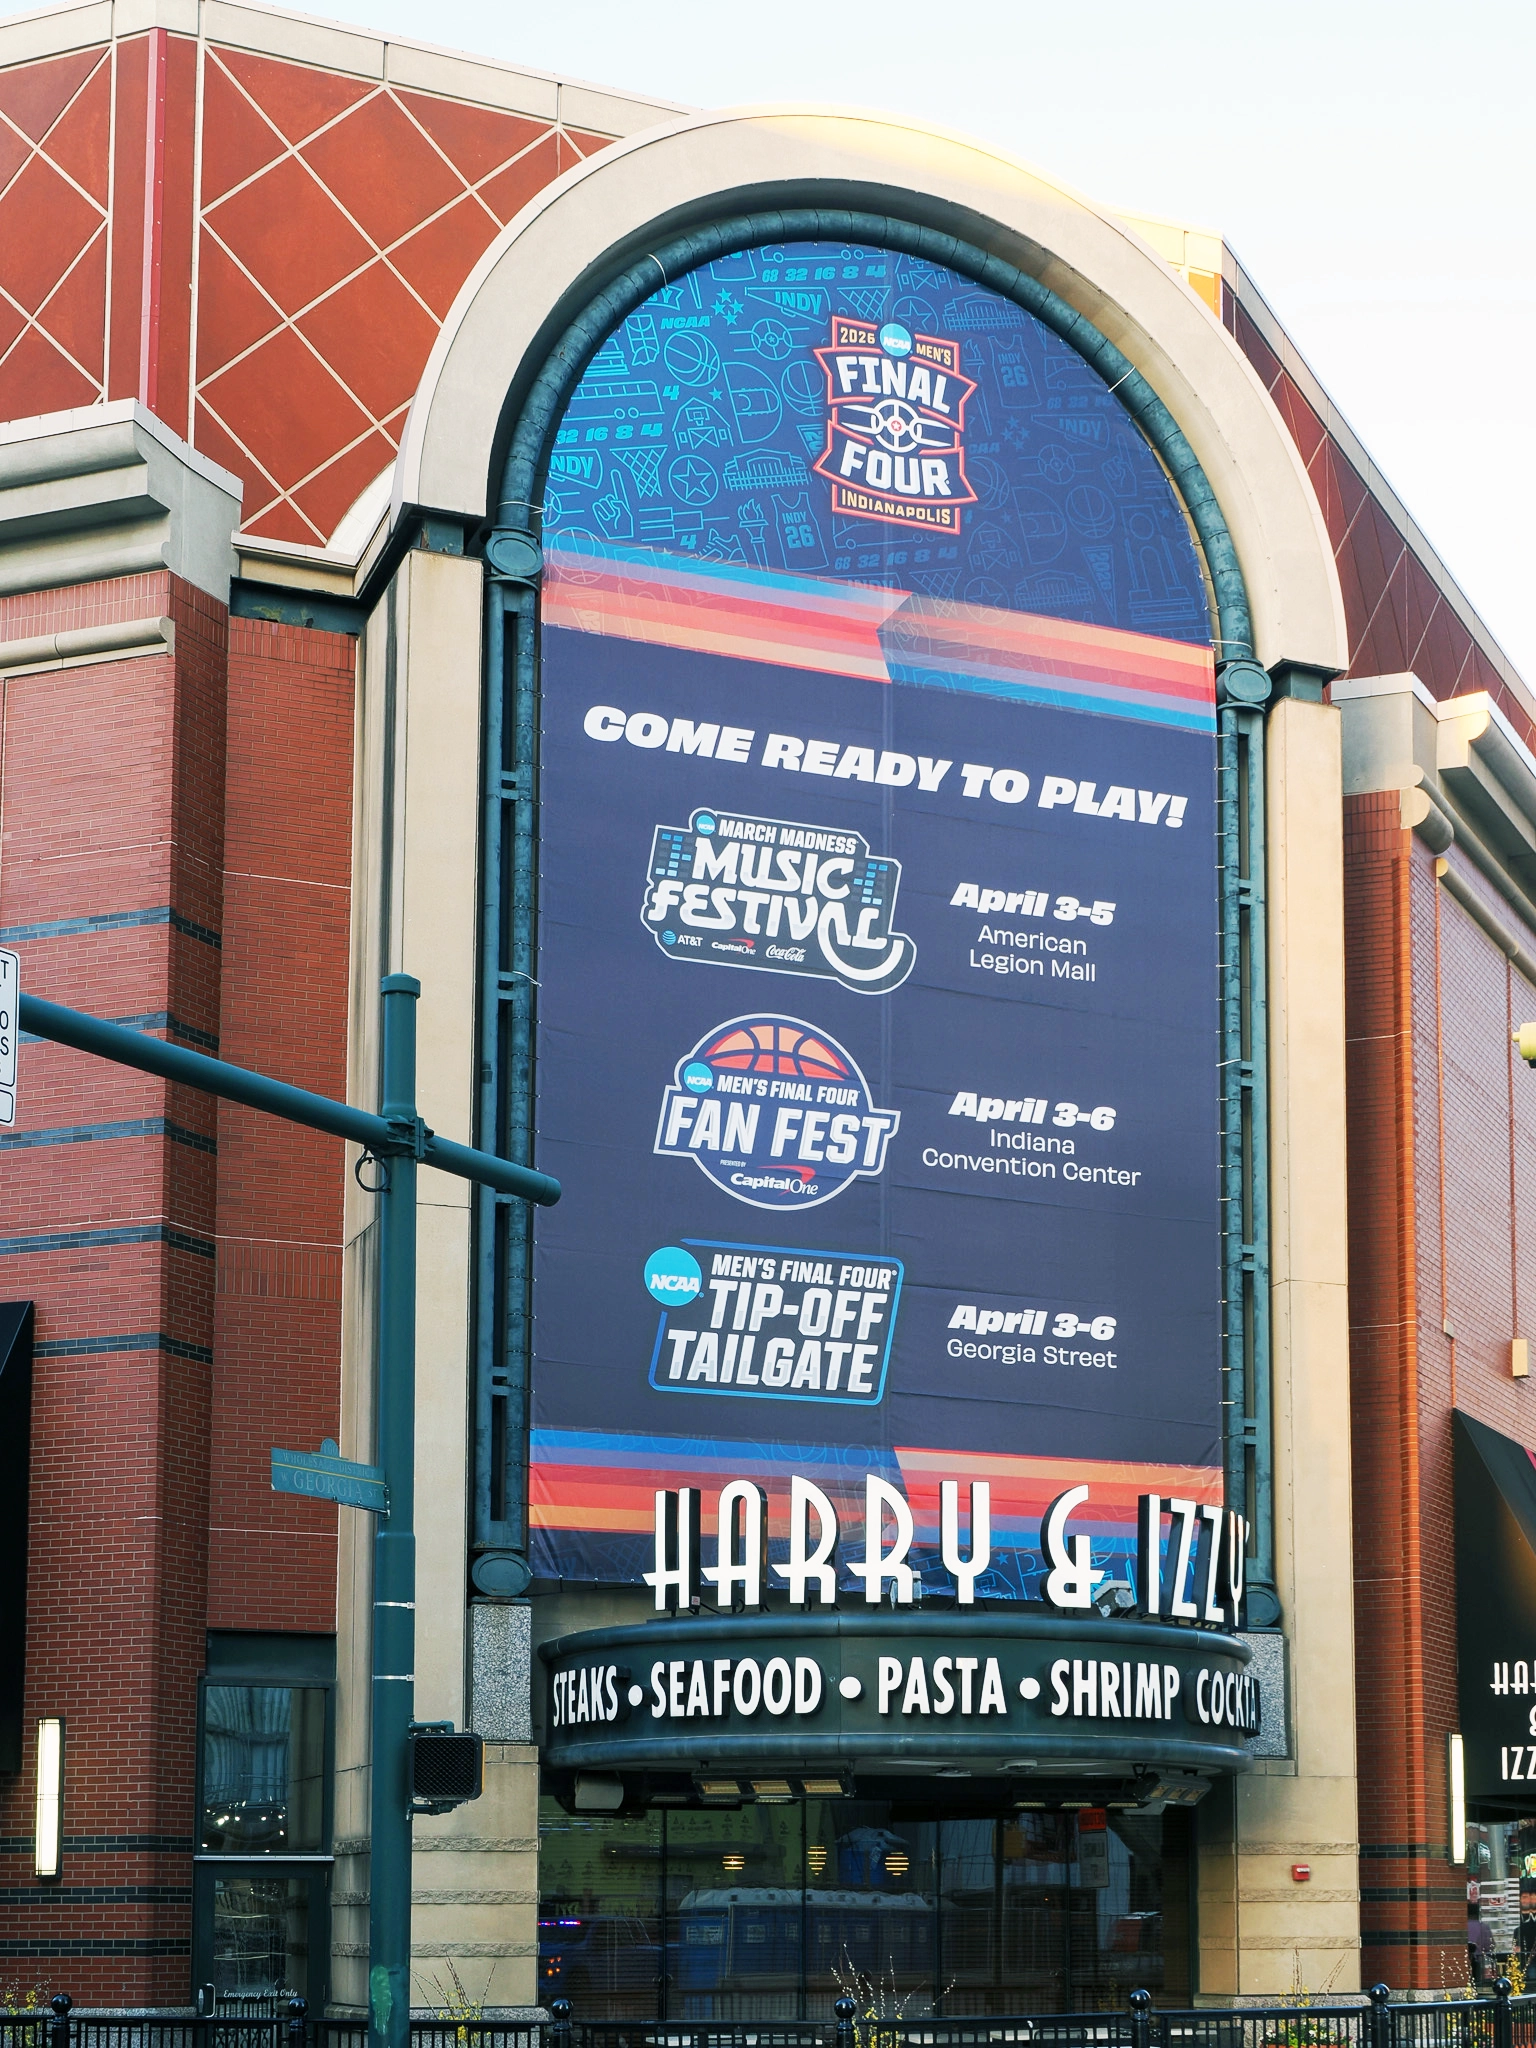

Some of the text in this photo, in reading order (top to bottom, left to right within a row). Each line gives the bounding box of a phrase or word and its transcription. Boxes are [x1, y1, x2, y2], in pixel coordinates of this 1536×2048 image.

[762, 265, 886, 283] 68 32 16 8 4
[775, 291, 821, 315] INDY
[660, 315, 710, 329] NCAA
[840, 327, 876, 344] 2026
[916, 343, 952, 366] MEN'S
[998, 353, 1021, 364] INDY
[836, 356, 950, 414] FINAL
[1001, 365, 1029, 387] 26
[663, 386, 679, 400] 4
[585, 427, 609, 442] 16
[615, 425, 634, 439] 8
[640, 423, 663, 437] 4
[1059, 418, 1101, 440] INDY
[968, 442, 1000, 454] CAA
[550, 455, 594, 479] NDY
[839, 440, 952, 496] FOUR
[782, 511, 807, 523] INDY
[841, 488, 951, 525] INDIANAPOLIS
[680, 534, 697, 549] 4
[785, 525, 815, 548] 26
[857, 554, 880, 568] 32
[886, 551, 907, 566] 16
[914, 549, 931, 562] 8
[583, 705, 1188, 828] COME READY TO PLAY!
[719, 819, 857, 855] MARCH MADNESS
[692, 837, 855, 899] MUSIC
[950, 882, 1116, 926] April 3-5
[648, 879, 904, 981] FESTIVAL
[677, 934, 703, 947] AT&T
[978, 925, 1087, 955] American
[970, 949, 1096, 982] Legion Mall
[686, 1075, 713, 1087] NCAA
[716, 1075, 859, 1107] MEN'S FINAL FOUR
[948, 1091, 1116, 1131] April 3-6
[664, 1095, 891, 1167] FAN FEST
[990, 1129, 1075, 1155] Indiana
[922, 1148, 1141, 1186] Convention Center
[650, 1274, 700, 1293] NCAA
[711, 1254, 892, 1290] MEN'S FINAL FOUR
[709, 1279, 888, 1340] TIP-OFF
[948, 1304, 1117, 1340] April 3-6
[667, 1329, 879, 1393] TAILGATE
[947, 1338, 1117, 1369] Georgia Street
[283, 1452, 375, 1479] WHOLESALE DISTRICT
[293, 1471, 362, 1498] GEORGIA
[642, 1473, 990, 1611] HARRY
[1043, 1484, 1105, 1608] &
[553, 1665, 618, 1728] STEAKS
[651, 1656, 822, 1719] SEAFOOD
[878, 1656, 1007, 1714] PASTA
[1050, 1658, 1180, 1720] SHRIMP
[1489, 1660, 1536, 1695] HA
[223, 1988, 298, 2000] Emergency Exit Only
